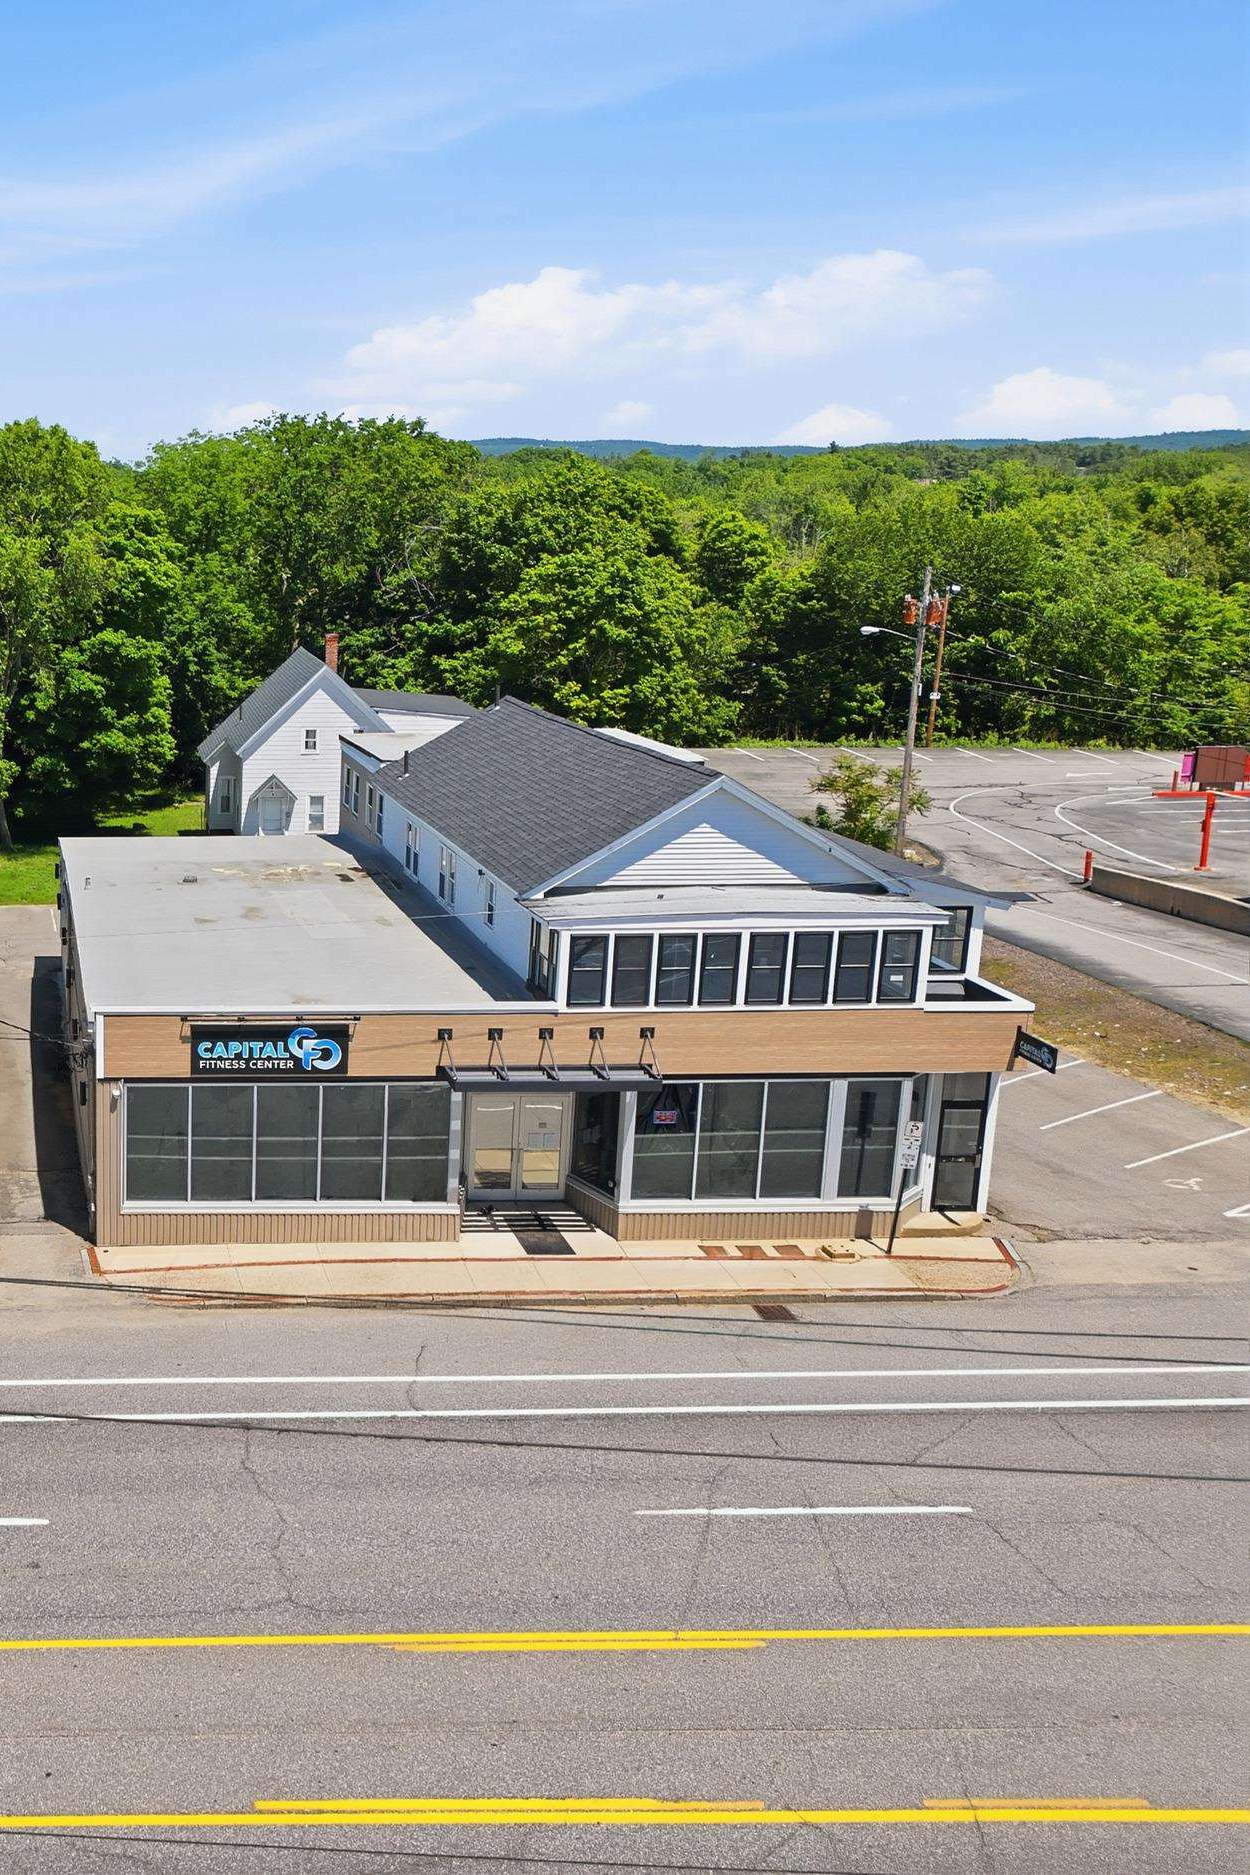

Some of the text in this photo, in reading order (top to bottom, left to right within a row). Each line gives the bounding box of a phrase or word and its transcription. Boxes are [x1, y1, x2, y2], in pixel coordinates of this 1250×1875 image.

[197, 1041, 290, 1059] CAPITAL
[199, 1060, 294, 1069] FITNESS CENTER
